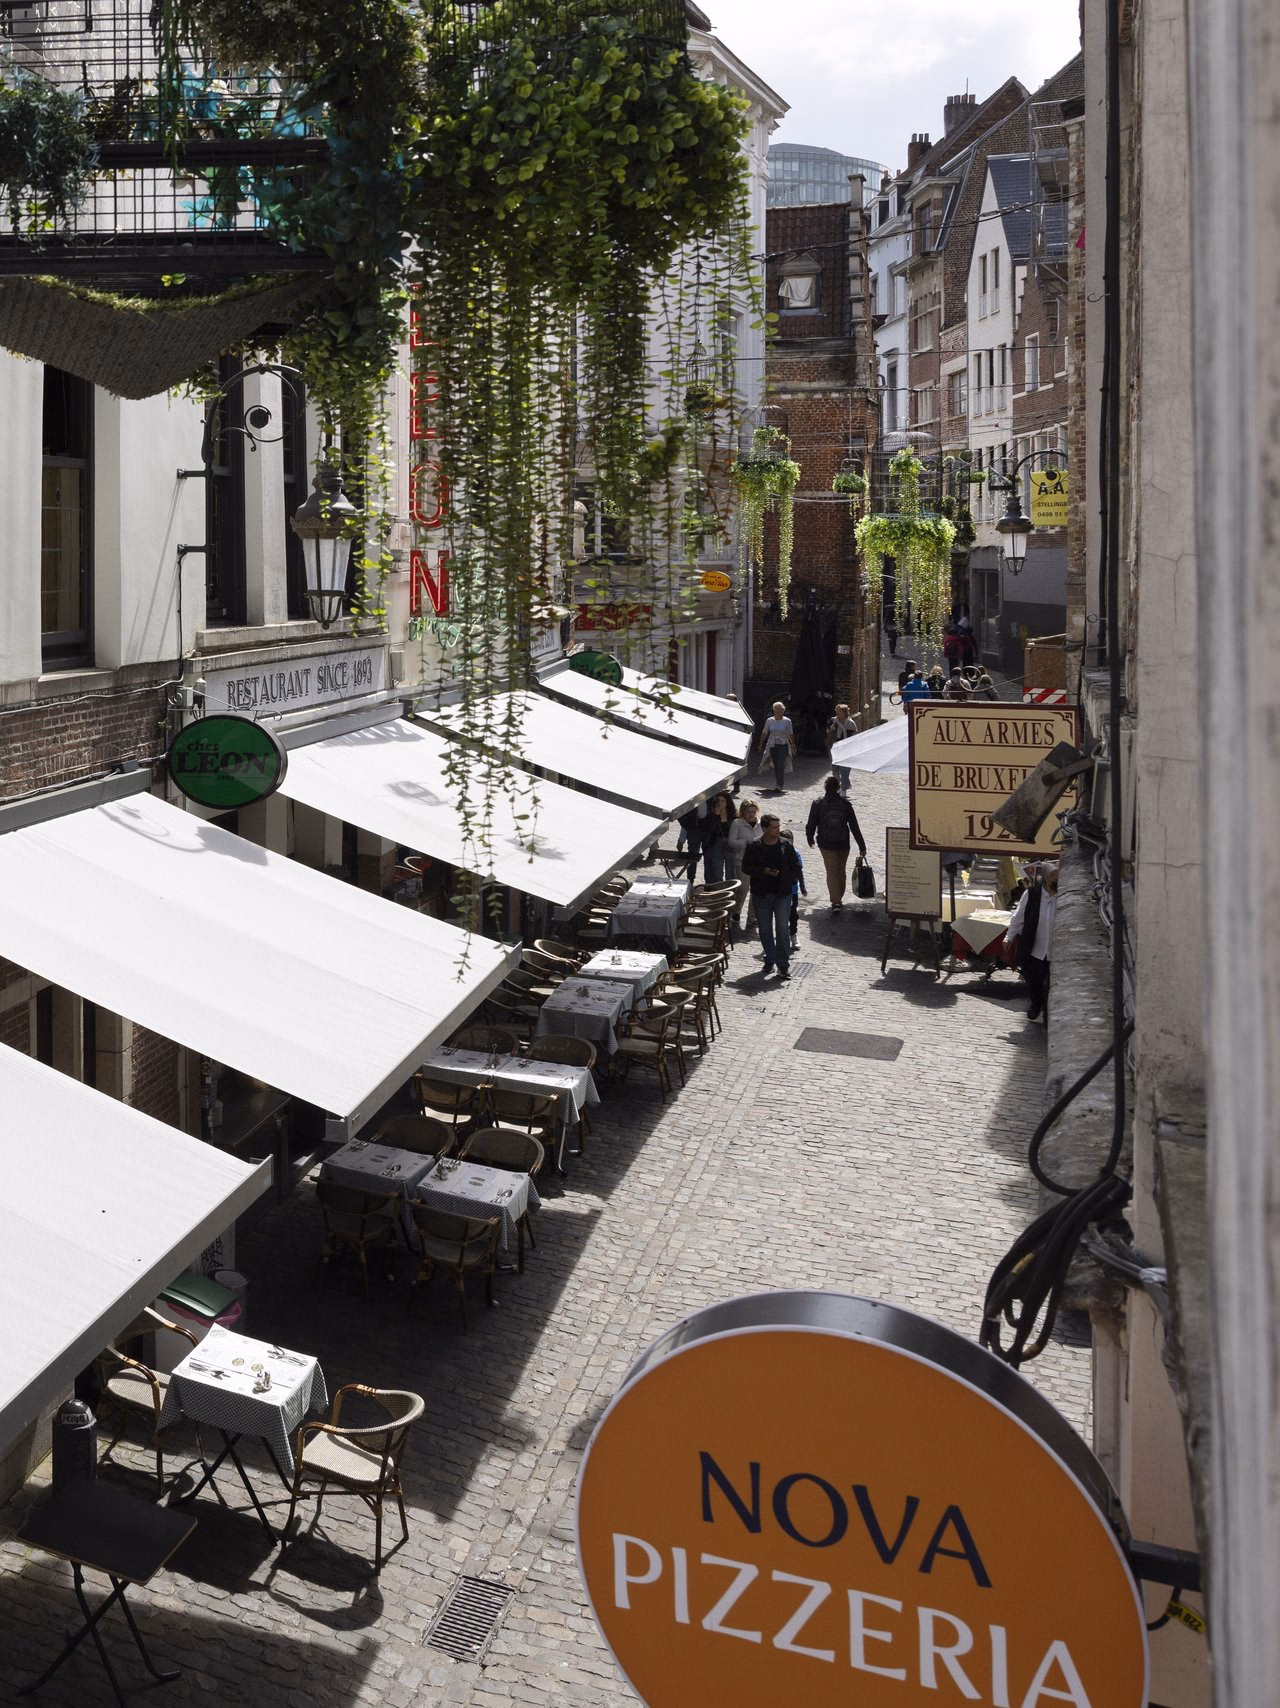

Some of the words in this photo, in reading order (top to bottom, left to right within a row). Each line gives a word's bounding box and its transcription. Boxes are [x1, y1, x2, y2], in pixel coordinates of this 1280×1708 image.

[227, 668, 311, 711] RESTAURANT
[317, 661, 348, 695] SINCE
[353, 656, 373, 687] 1893
[187, 740, 220, 752] chez
[933, 719, 972, 744] AUX
[983, 721, 1055, 746] ARMES
[176, 751, 270, 775] LEON
[916, 764, 942, 788] DE
[698, 1451, 993, 1588] NOVA
[612, 1533, 1093, 1708] PIZZERIA
